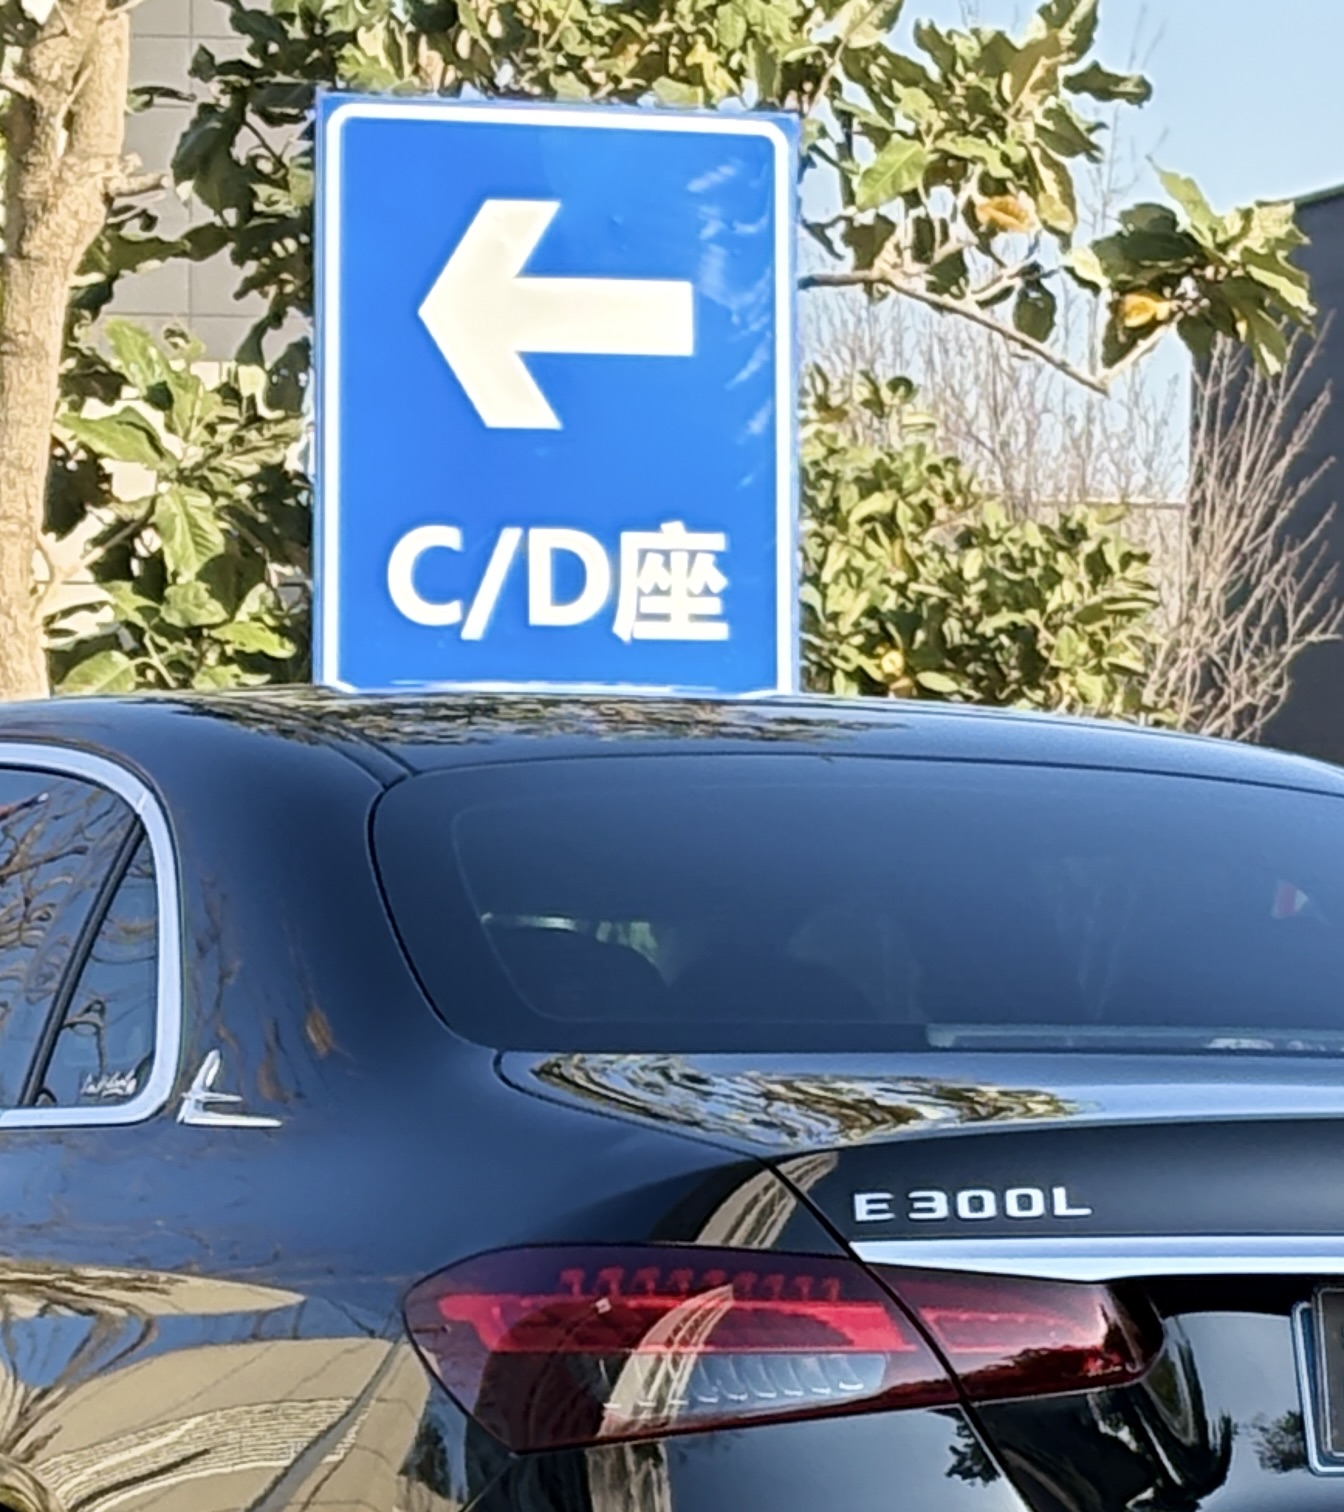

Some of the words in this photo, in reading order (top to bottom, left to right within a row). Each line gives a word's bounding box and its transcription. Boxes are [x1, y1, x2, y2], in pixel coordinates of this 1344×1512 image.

[386, 520, 730, 643] C/D座
[854, 1192, 895, 1222] E
[908, 1186, 1093, 1219] 300L
